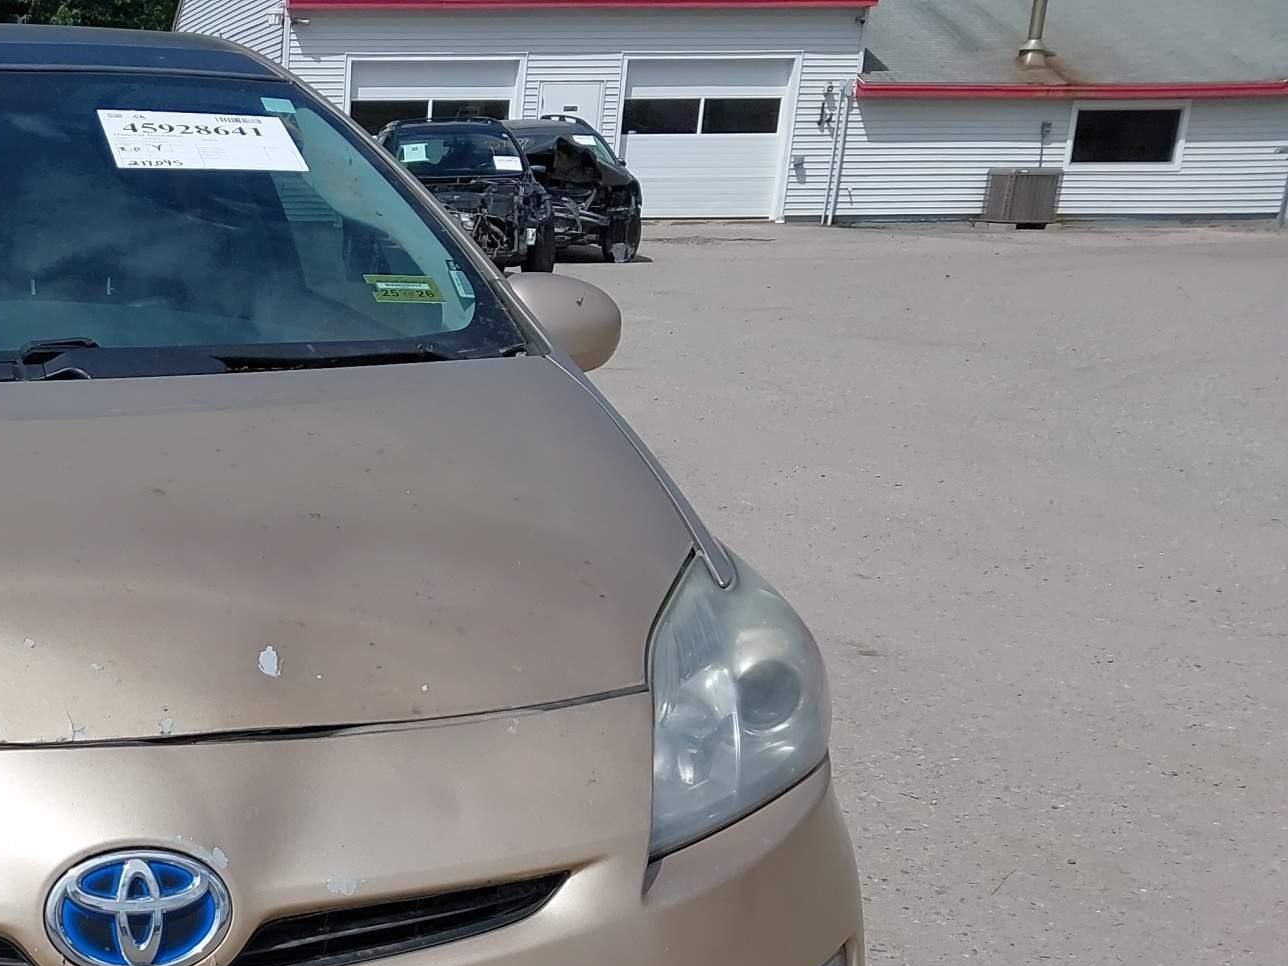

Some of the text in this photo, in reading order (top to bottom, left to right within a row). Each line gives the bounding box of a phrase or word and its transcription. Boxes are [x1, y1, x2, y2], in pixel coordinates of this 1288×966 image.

[123, 122, 263, 137] 45928641
[381, 289, 400, 297] 25
[416, 289, 435, 298] 26
